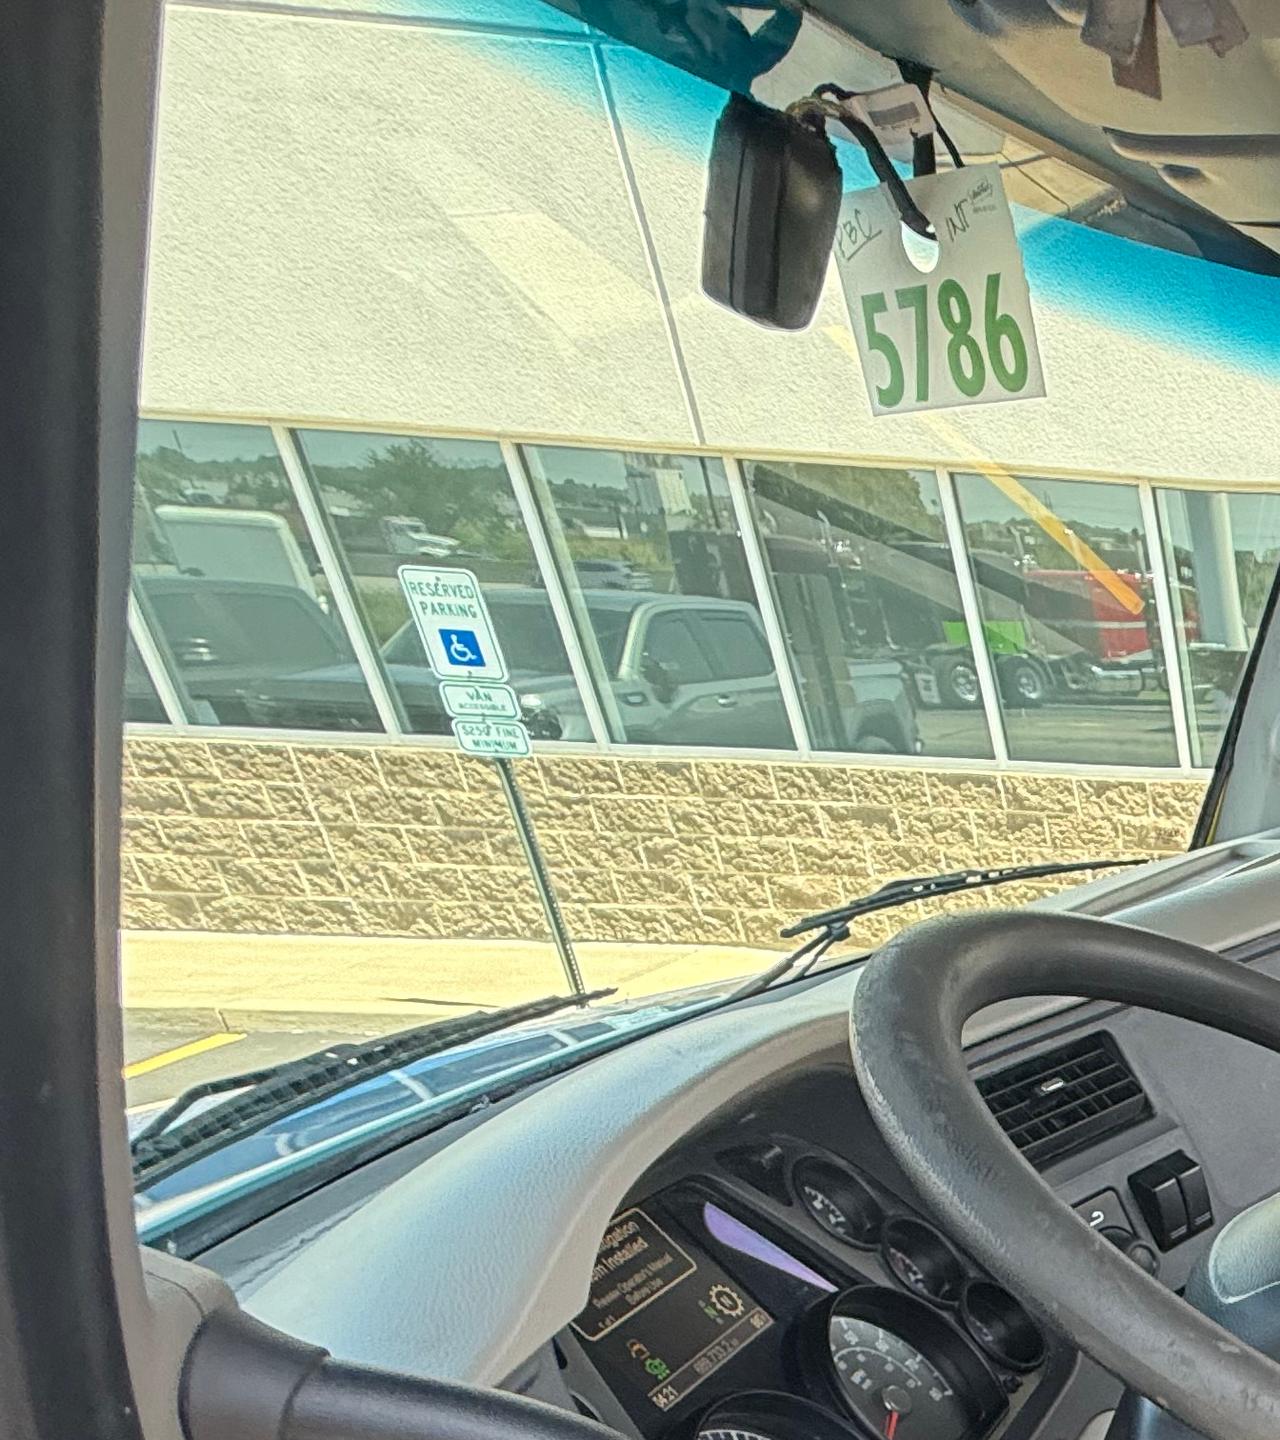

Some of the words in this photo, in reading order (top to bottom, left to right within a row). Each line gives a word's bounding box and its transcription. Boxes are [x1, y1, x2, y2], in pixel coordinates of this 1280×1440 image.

[861, 272, 1028, 408] 5786
[408, 581, 475, 599] RESERVED
[419, 601, 478, 618] PARKING
[466, 690, 492, 702] VAN
[496, 726, 521, 739] FINE
[472, 739, 518, 751] MINIMUM
